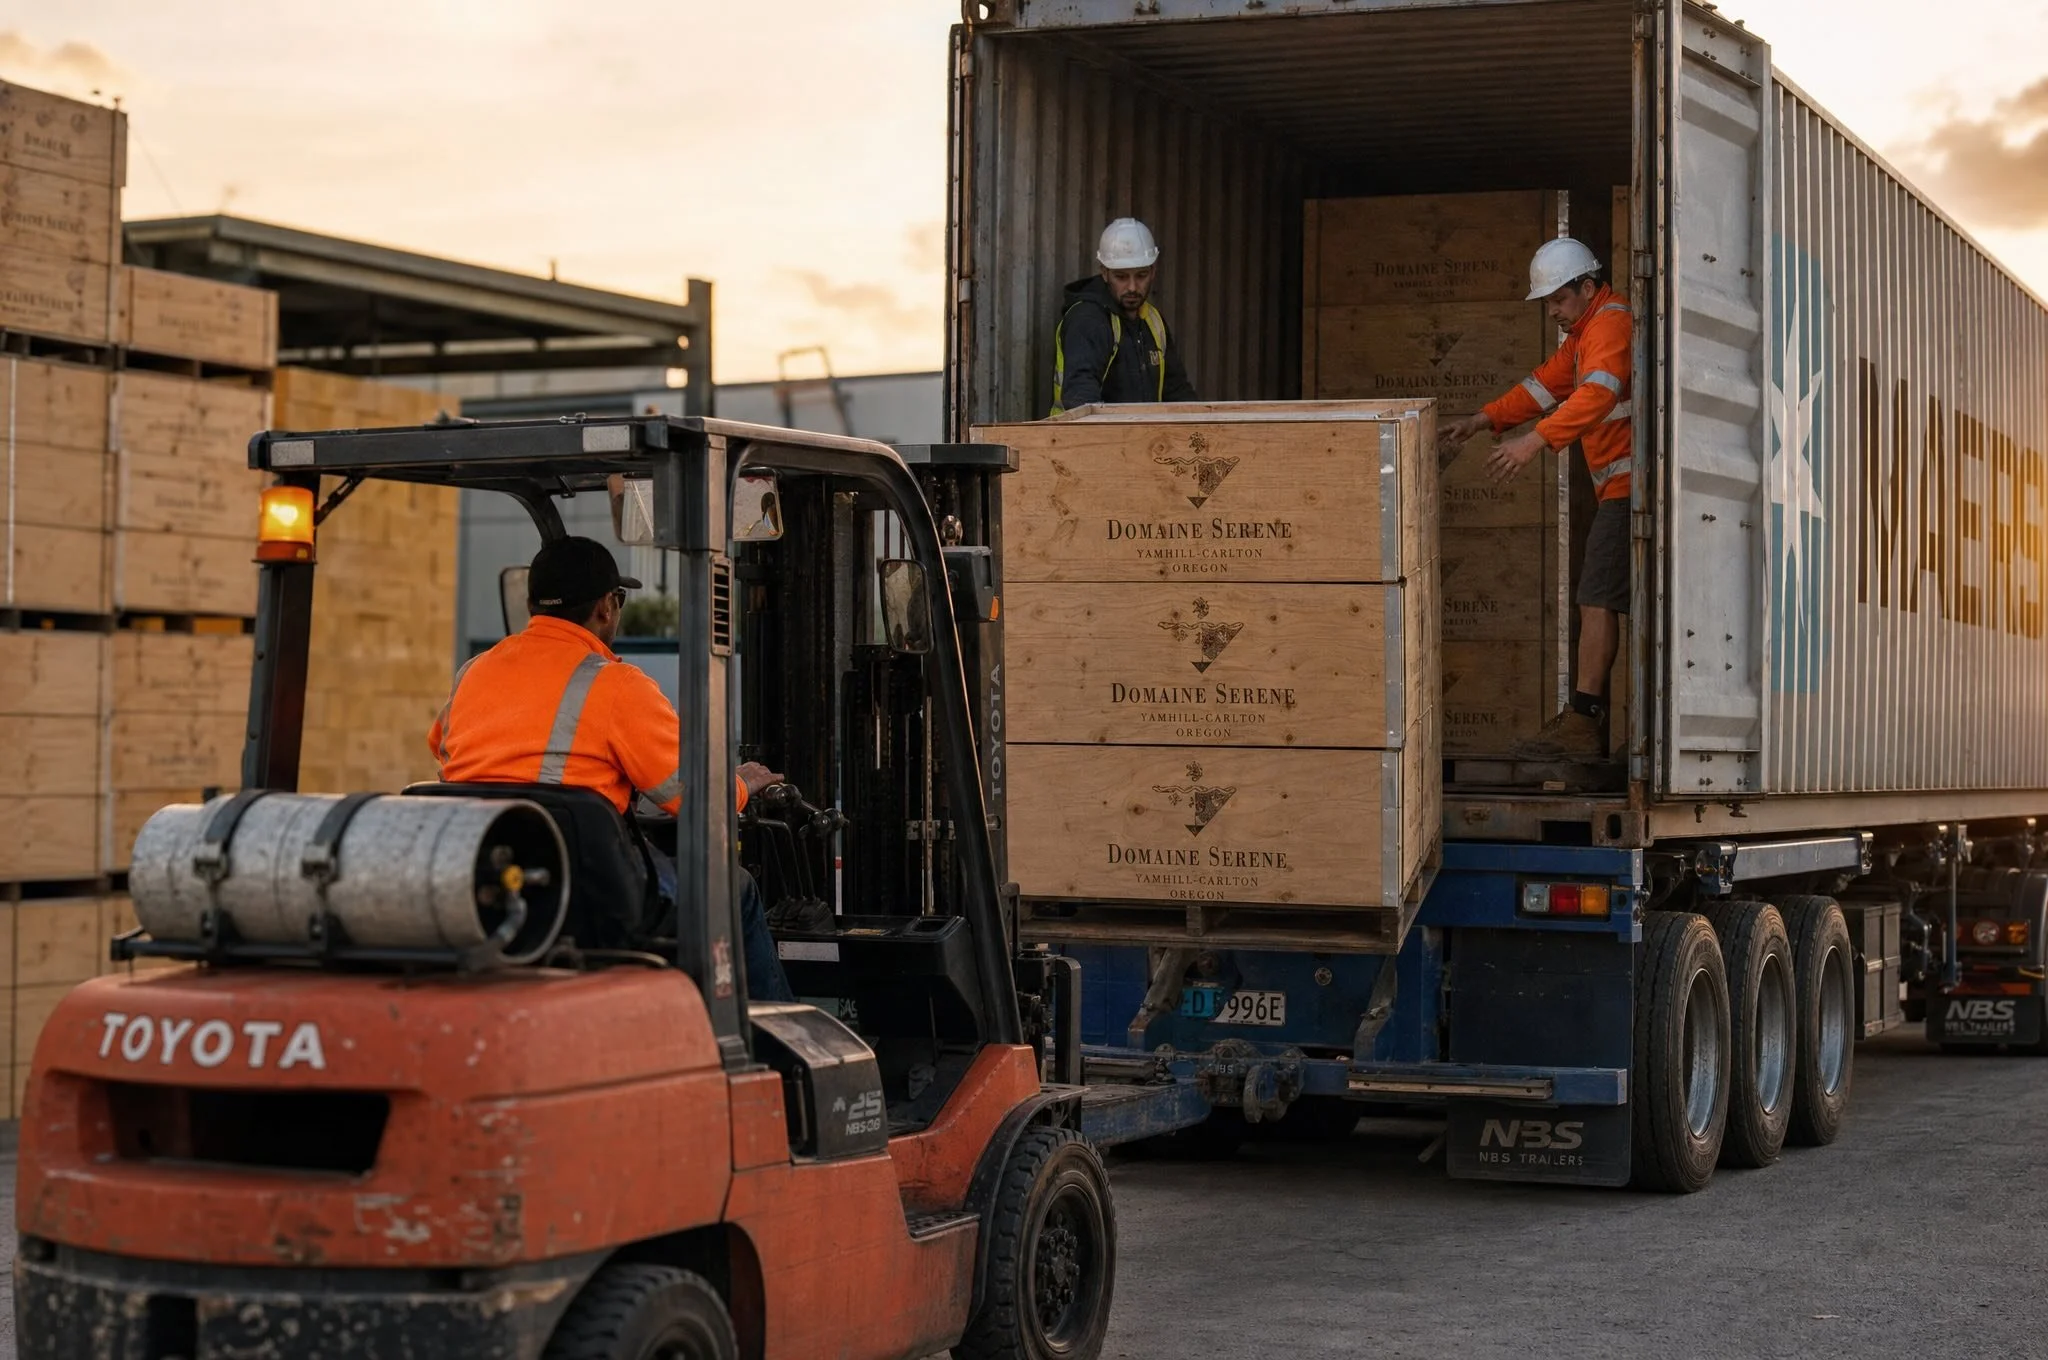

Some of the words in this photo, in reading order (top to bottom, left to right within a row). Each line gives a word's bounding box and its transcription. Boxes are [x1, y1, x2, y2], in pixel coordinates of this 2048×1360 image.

[1375, 262, 1439, 277] DOMAINE
[1444, 258, 1499, 274] SERENE
[1375, 374, 1438, 388] DOMAINE
[1444, 370, 1499, 386] SERENE
[1444, 485, 1498, 500] SERENE
[1107, 519, 1202, 540] DOMAINE
[1212, 518, 1292, 539] SERENE
[1137, 548, 1263, 558] YAMHILL-CARLTON
[1172, 563, 1229, 573] OREGON
[1444, 597, 1498, 613] SERENE
[1111, 682, 1206, 704] DOMAINE
[1215, 682, 1296, 705] SERENE
[1141, 713, 1266, 723] YAMHILL-CARLTON
[1444, 709, 1498, 725] SERENE
[991, 663, 1001, 801] TOYOTA
[1176, 728, 1232, 738] OREGON
[1107, 843, 1200, 865] DOMAINE
[1209, 846, 1287, 868] SERENE
[1136, 873, 1258, 887] YAMHILL-CARLTON
[1170, 889, 1224, 900] OREGON
[1945, 1000, 2016, 1020] NBS
[99, 1013, 326, 1070] TOYOTA
[848, 1090, 881, 1120] 25
[1479, 1119, 1585, 1150] NBS
[1479, 1151, 1512, 1164] NBS
[1519, 1153, 1584, 1166] TRAILERS
